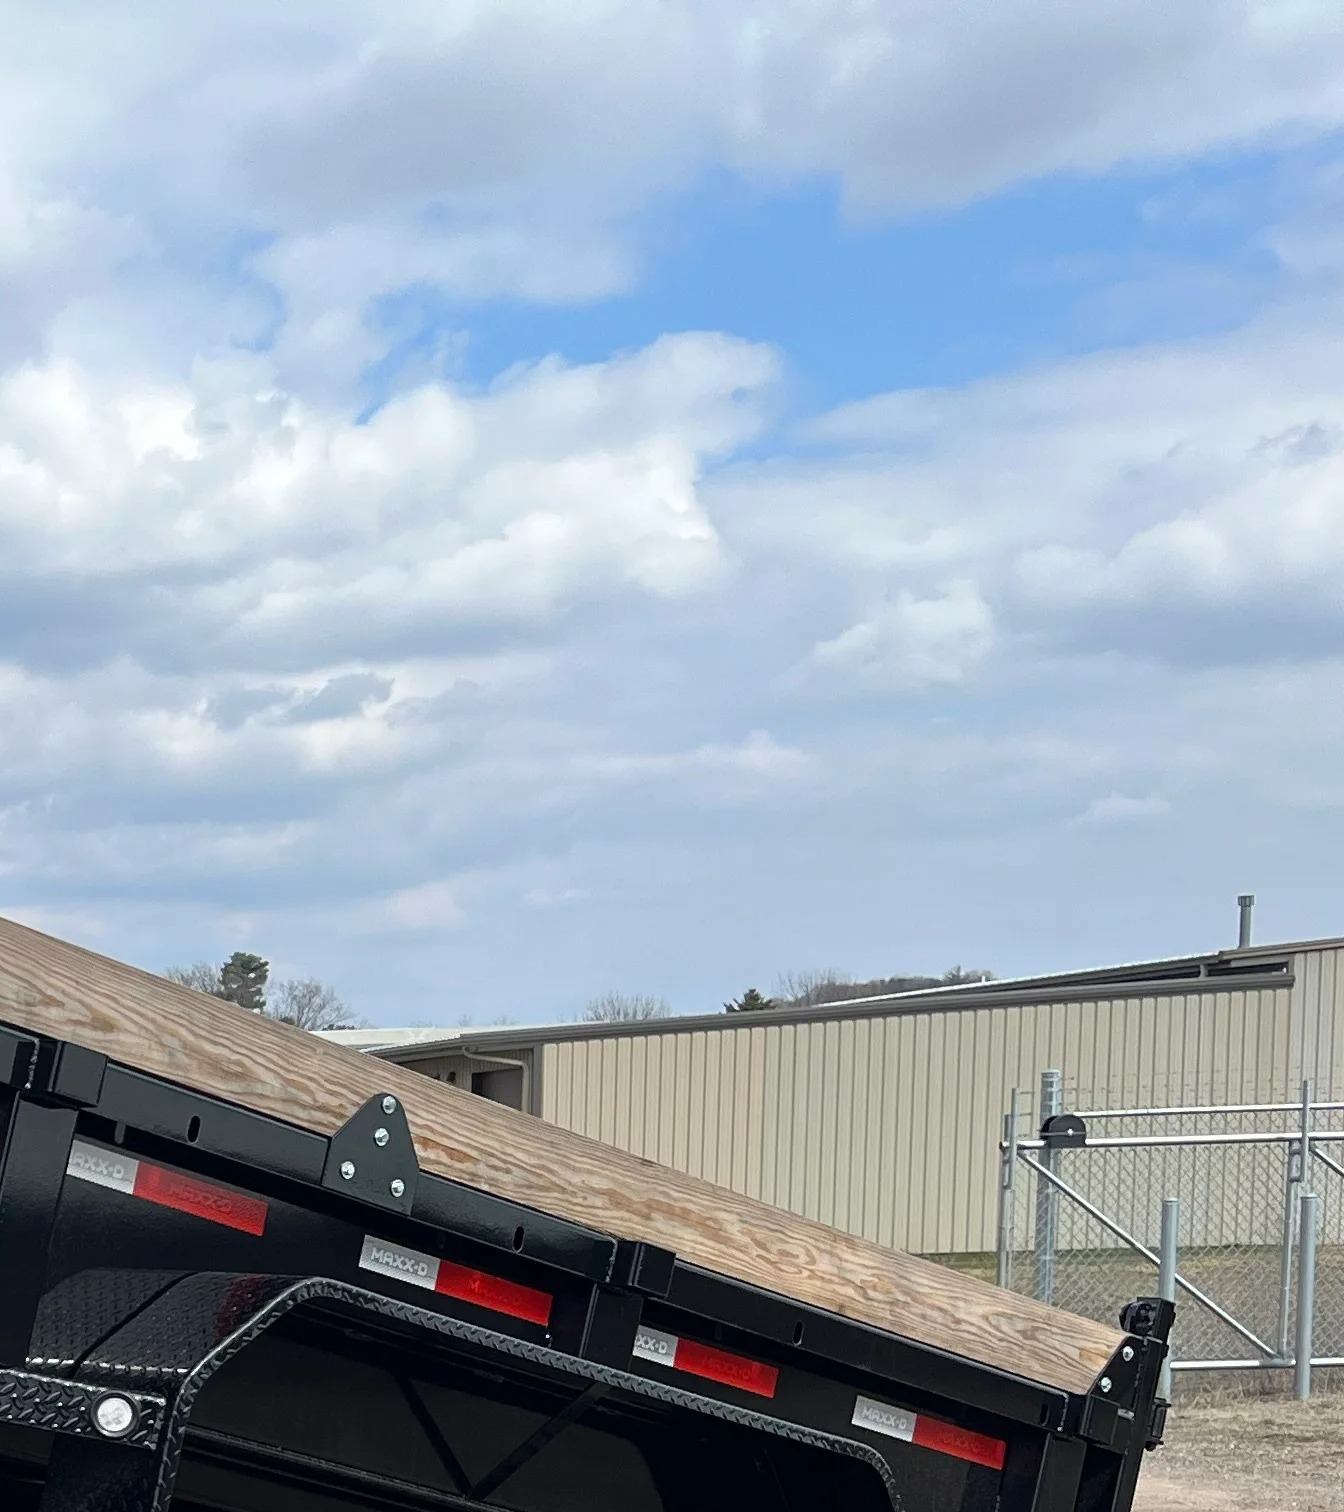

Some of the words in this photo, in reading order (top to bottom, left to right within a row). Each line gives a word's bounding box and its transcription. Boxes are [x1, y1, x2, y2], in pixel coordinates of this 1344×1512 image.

[72, 1152, 125, 1179] AXX-D
[370, 1247, 428, 1277] MAXX-D
[636, 1334, 668, 1354] XX-D
[862, 1405, 907, 1430] MAXX-D
